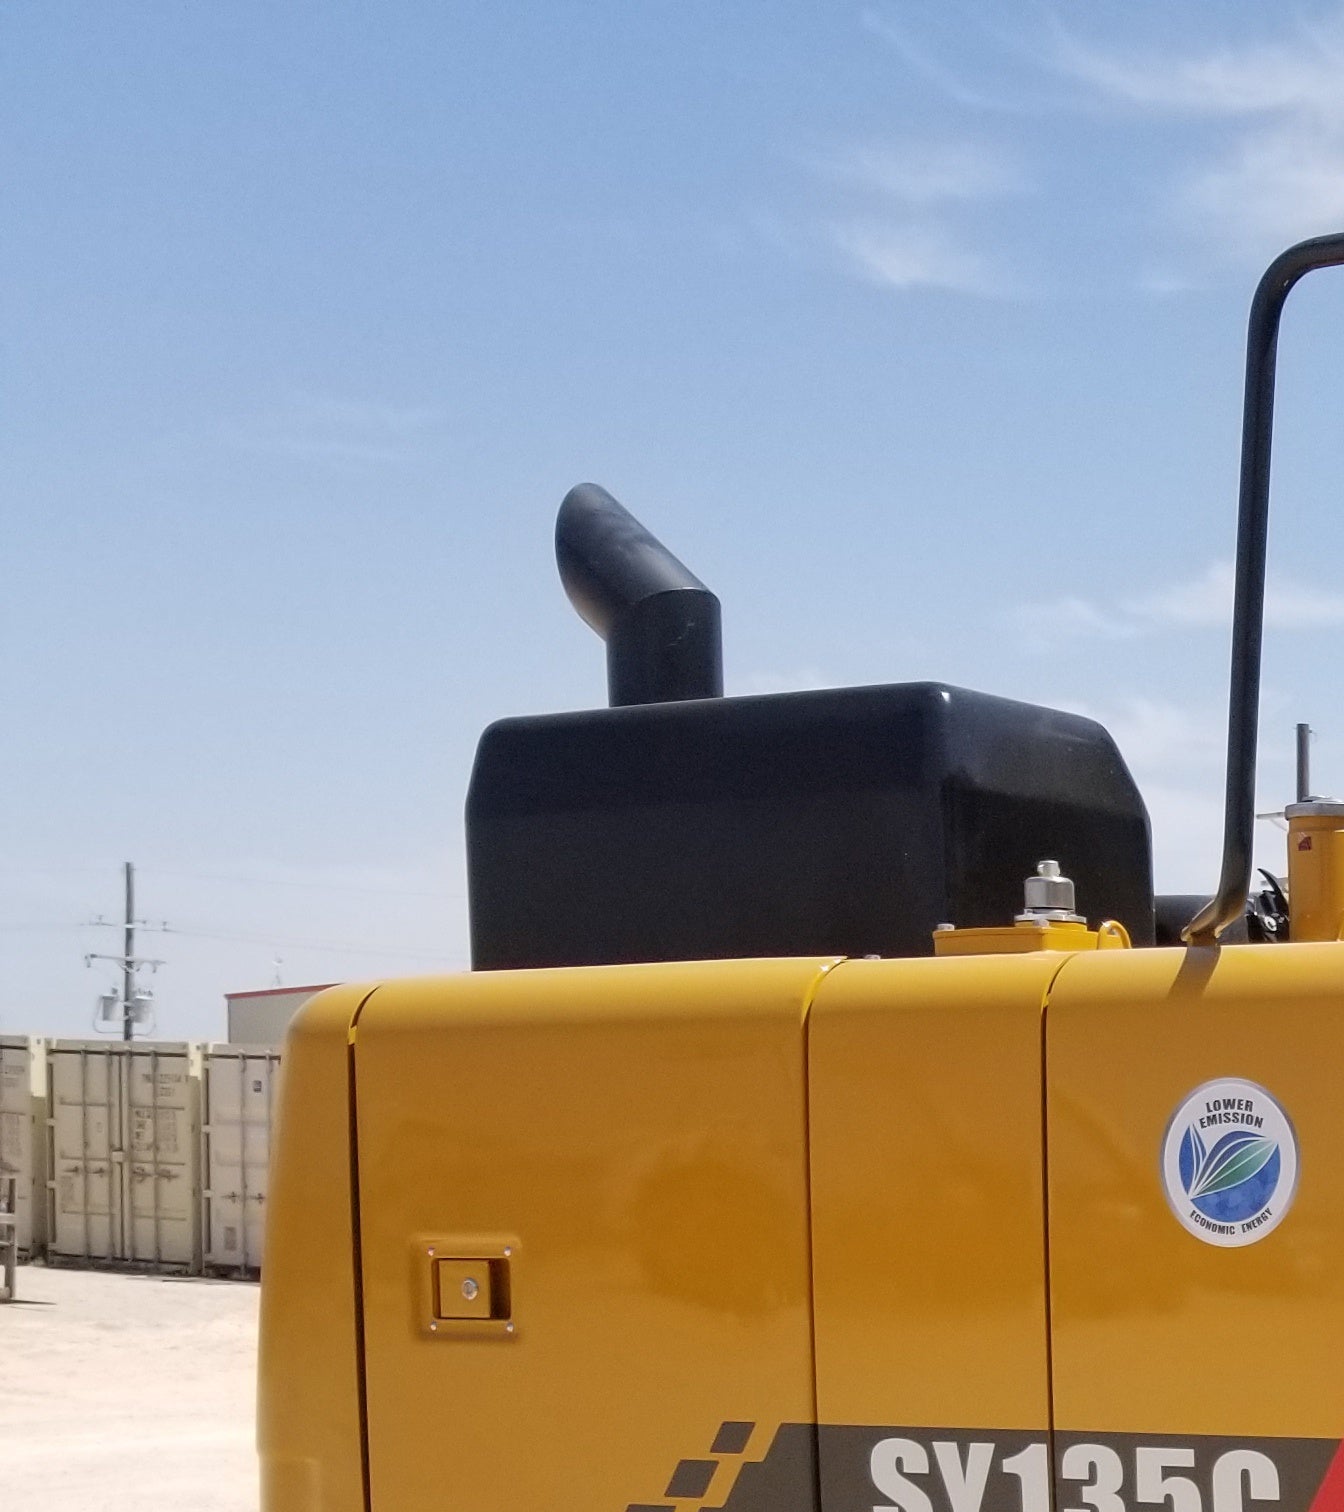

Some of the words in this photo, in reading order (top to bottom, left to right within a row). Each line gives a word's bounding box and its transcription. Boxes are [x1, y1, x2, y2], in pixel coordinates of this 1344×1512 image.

[1206, 1098, 1254, 1113] LOWER
[1199, 1112, 1264, 1129] EMISSION
[1190, 1209, 1236, 1235] ECONOMIC
[1241, 1207, 1273, 1234] ENERGY
